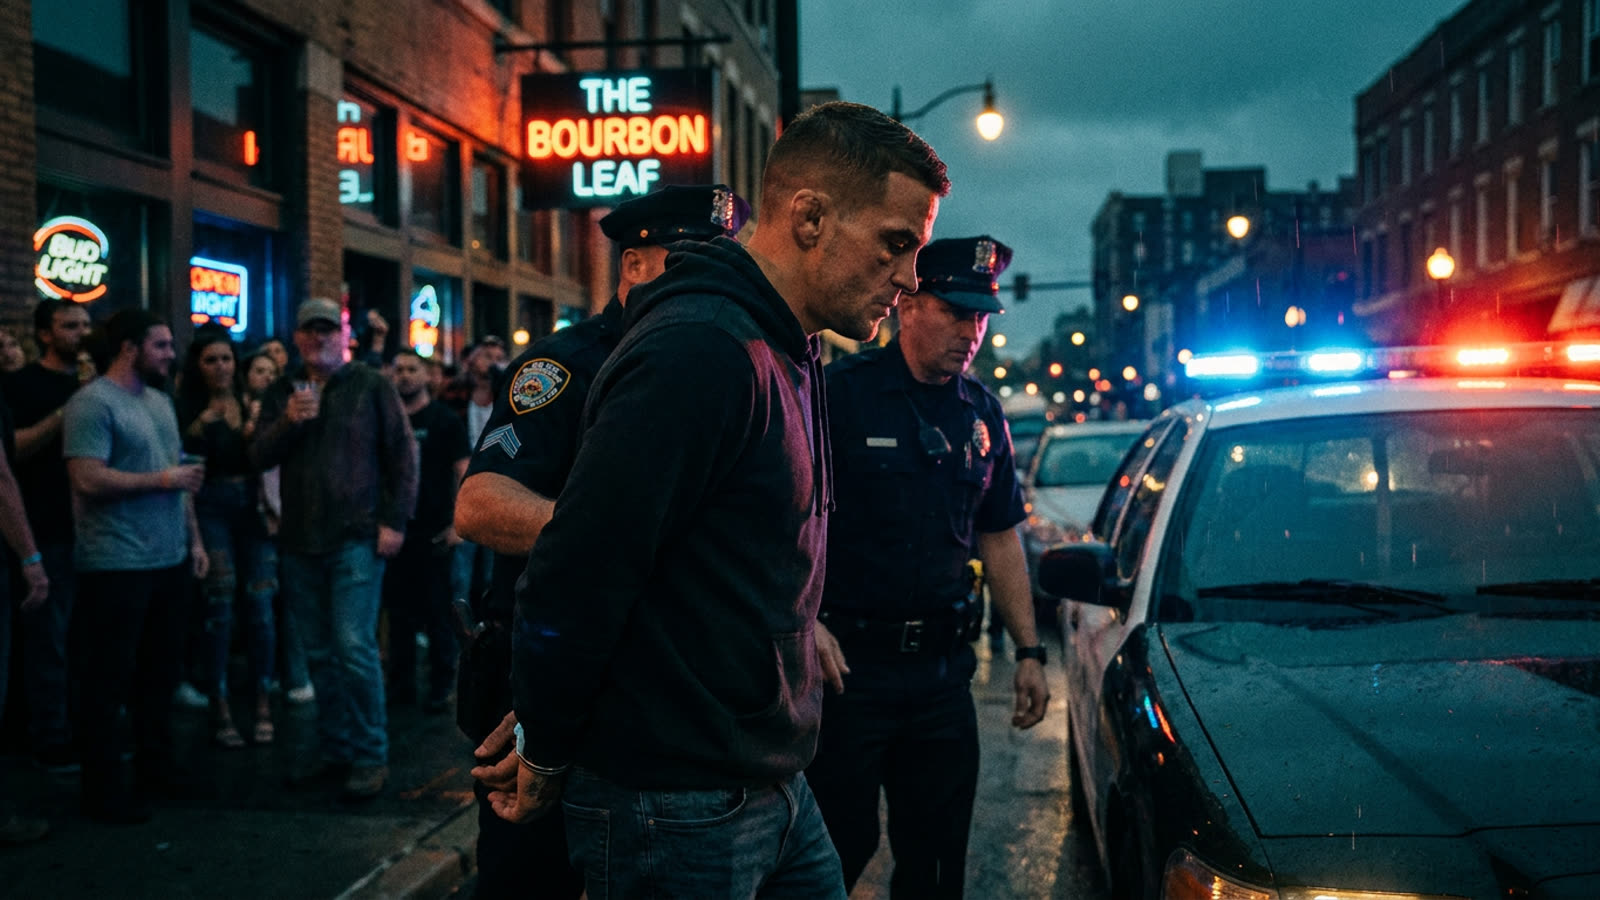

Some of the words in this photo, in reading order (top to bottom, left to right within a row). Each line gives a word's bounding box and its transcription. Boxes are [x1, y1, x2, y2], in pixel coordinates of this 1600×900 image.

[579, 77, 653, 114] THE
[527, 114, 706, 158] BOURBON
[572, 159, 661, 197] LEAF
[48, 232, 101, 263] BUD
[39, 253, 109, 287] LIGHT
[190, 266, 241, 296] OPEN
